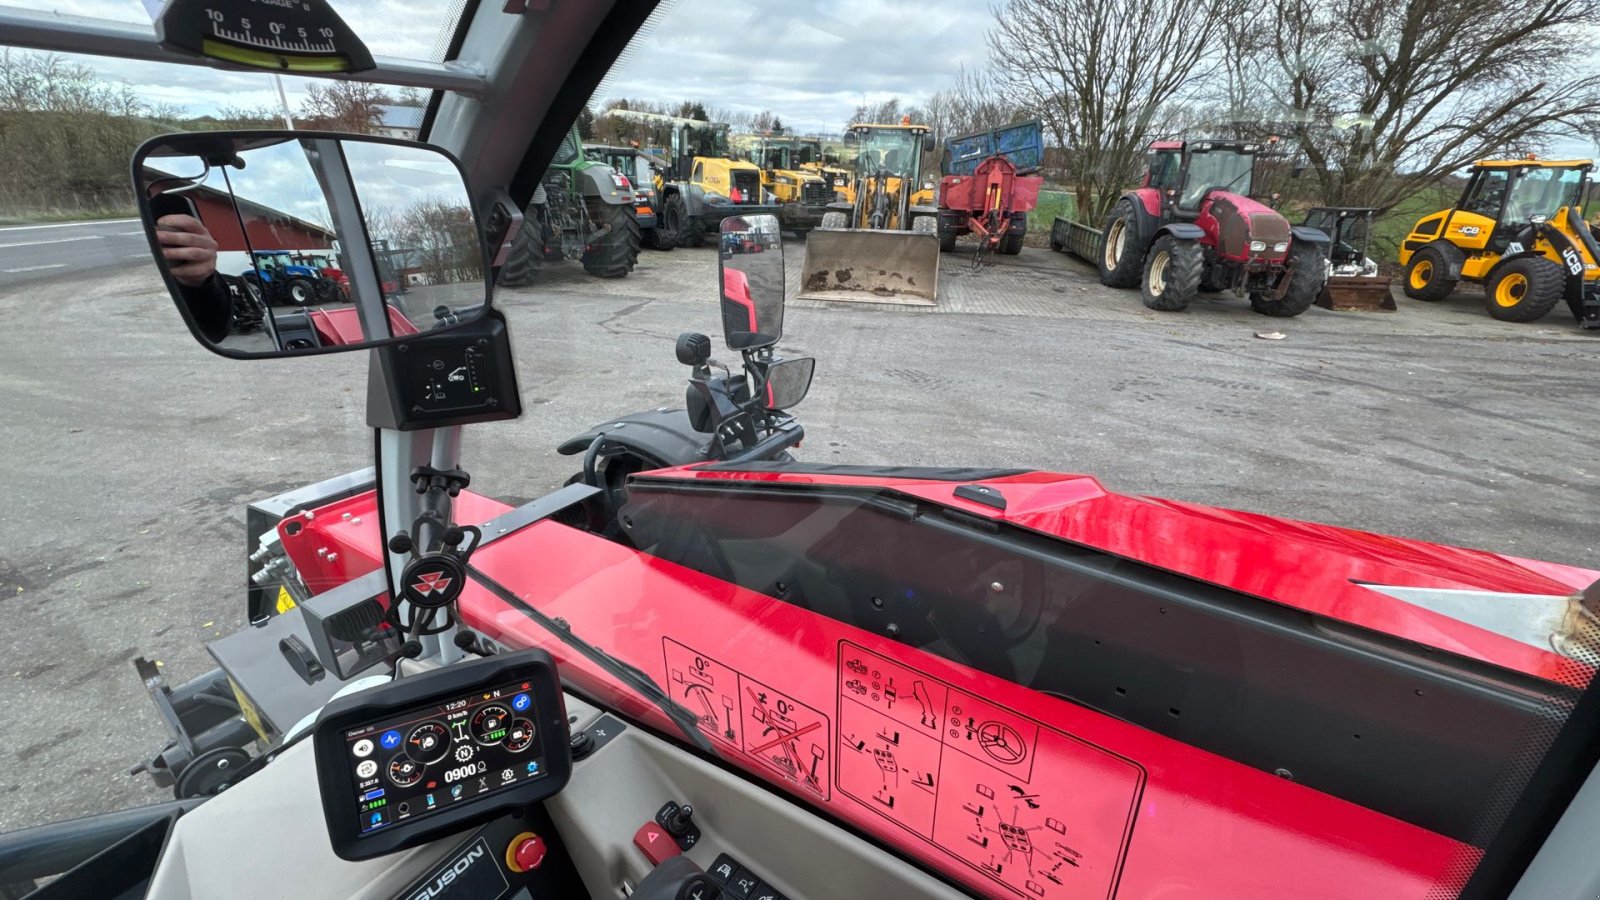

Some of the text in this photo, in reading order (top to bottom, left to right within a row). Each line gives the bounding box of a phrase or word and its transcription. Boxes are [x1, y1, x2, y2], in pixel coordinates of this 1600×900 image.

[205, 9, 224, 22] 10
[241, 18, 251, 29] 5
[297, 27, 307, 37] 5
[318, 27, 334, 38] 10
[1457, 226, 1480, 234] JCB
[1562, 249, 1583, 275] JCB
[695, 657, 709, 671] 0°
[493, 690, 500, 698] N
[446, 700, 466, 711] 12:20
[453, 710, 468, 719] km/h
[460, 749, 468, 758] N
[444, 763, 476, 783] 0900
